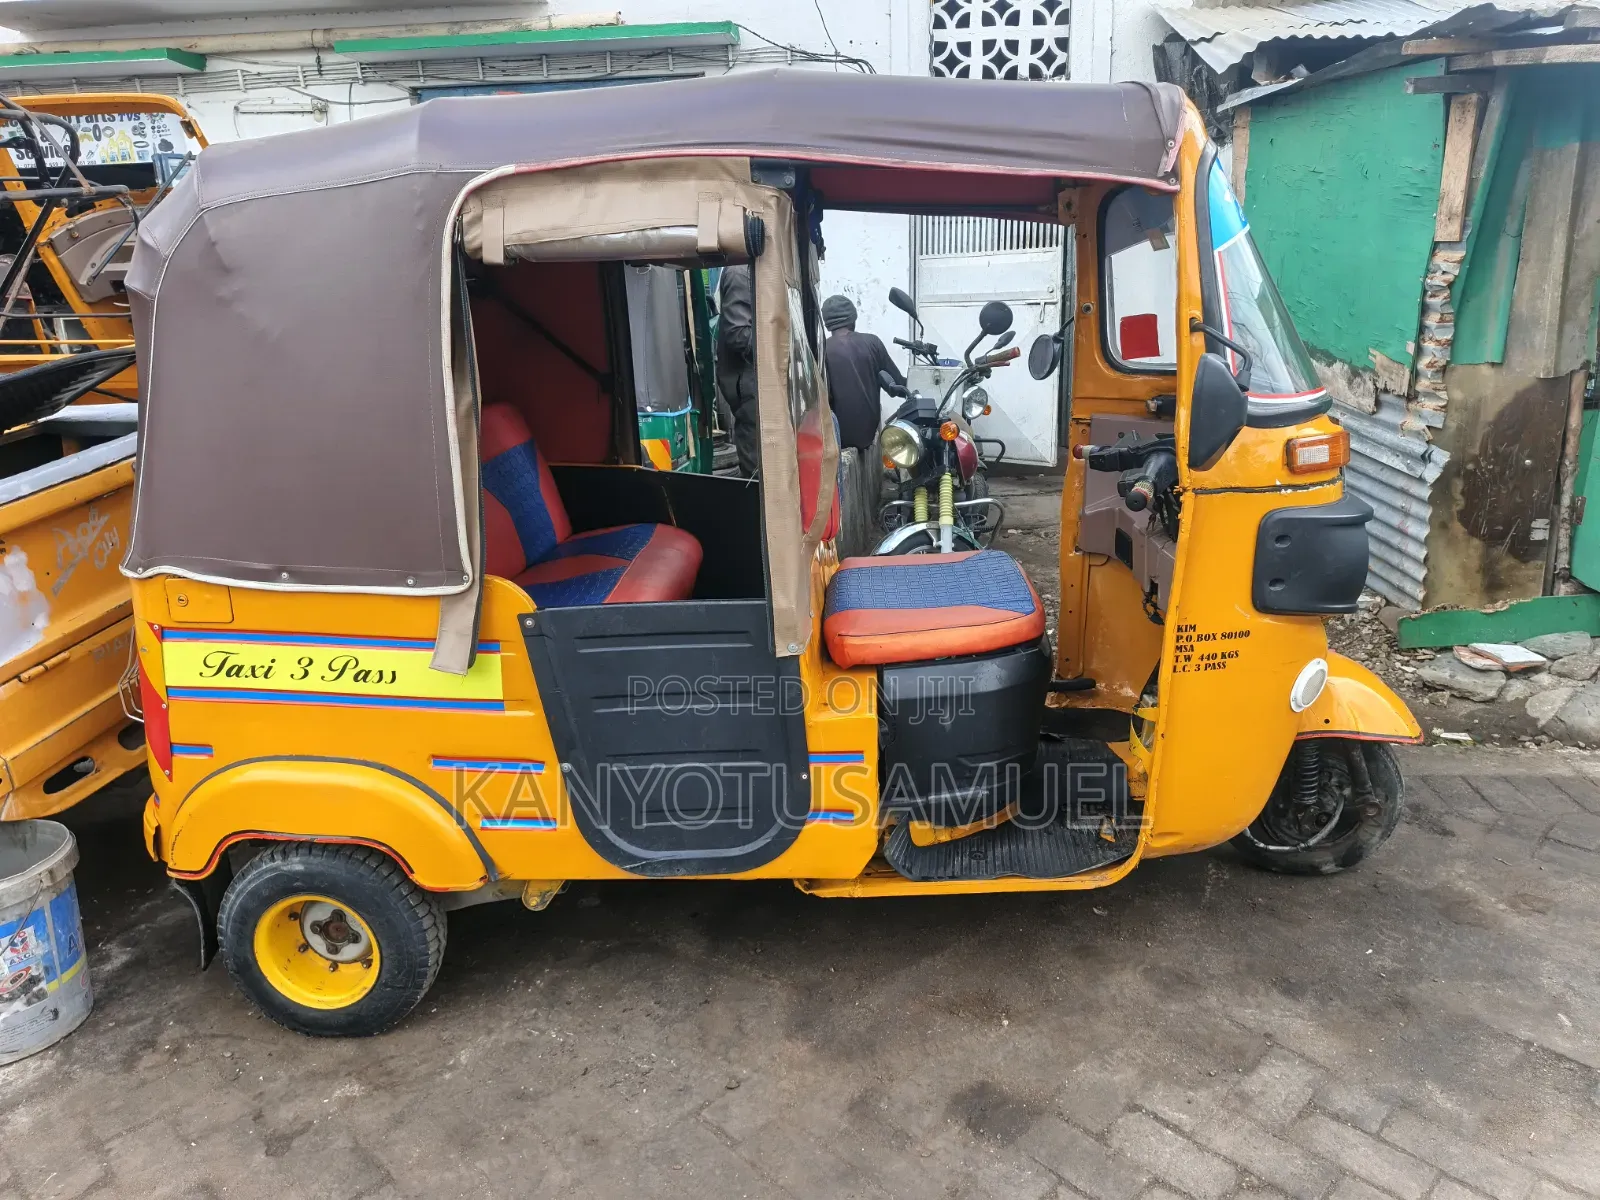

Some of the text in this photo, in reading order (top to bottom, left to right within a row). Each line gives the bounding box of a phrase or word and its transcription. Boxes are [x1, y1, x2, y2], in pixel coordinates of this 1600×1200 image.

[1176, 624, 1197, 633] KIM
[1220, 629, 1251, 640] 80100
[1174, 644, 1195, 653] MSA
[1198, 652, 1218, 662] 440
[1220, 650, 1240, 660] KGS
[198, 650, 398, 685] Taxi 3 Pass
[1194, 663, 1201, 673] 3
[1204, 661, 1227, 671] PASS
